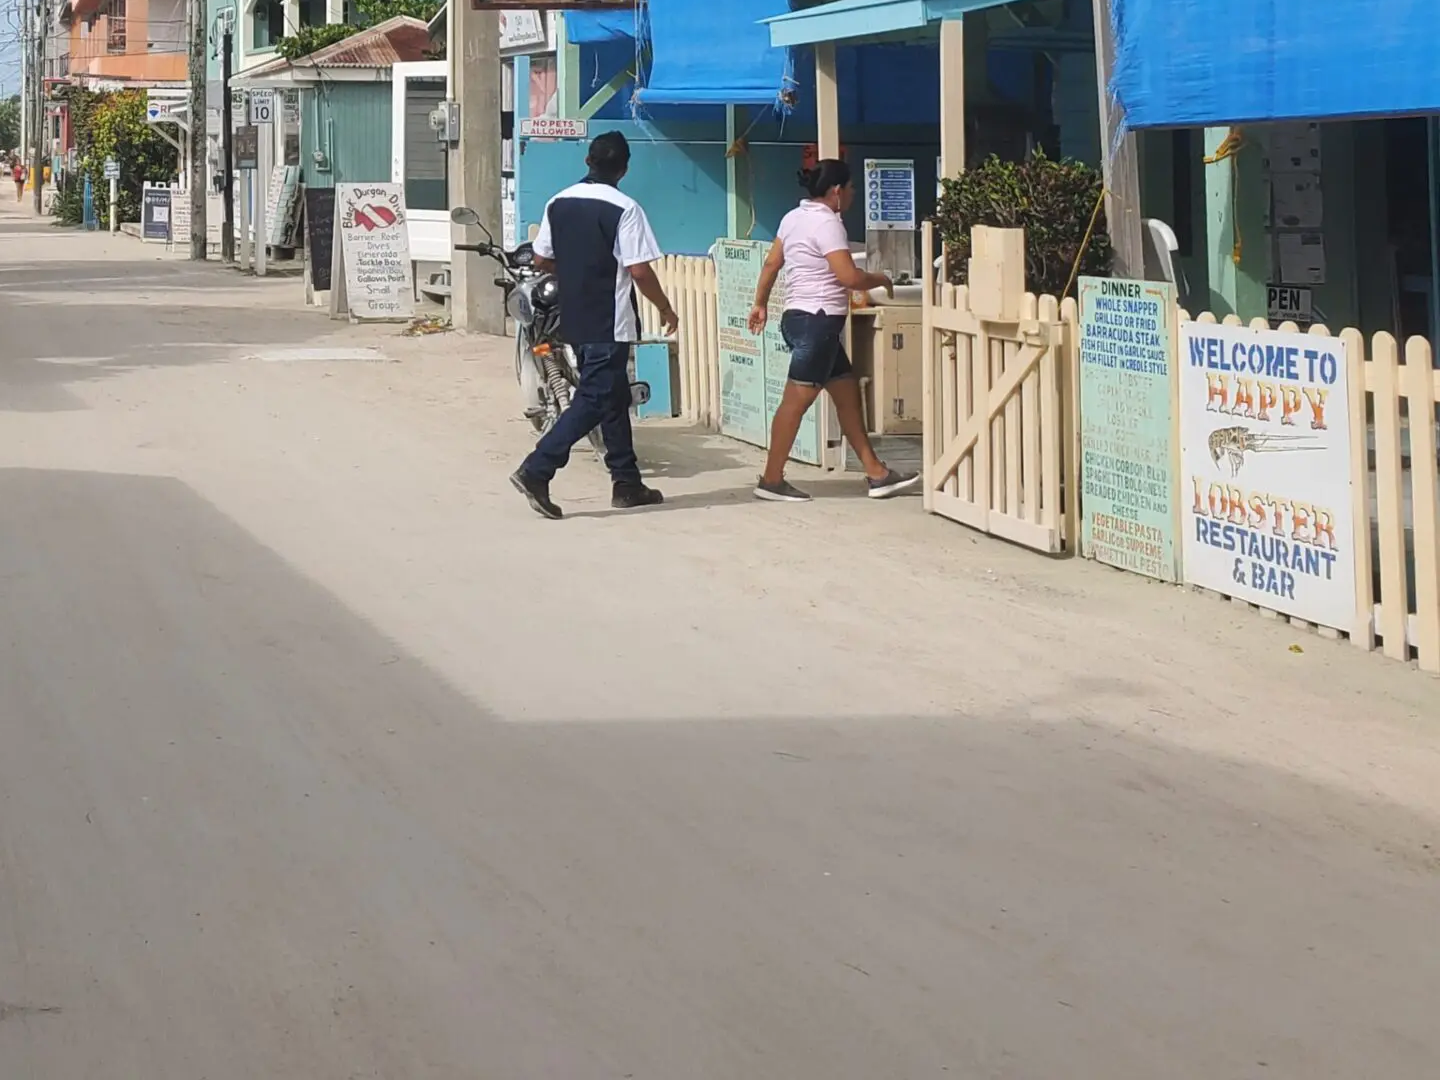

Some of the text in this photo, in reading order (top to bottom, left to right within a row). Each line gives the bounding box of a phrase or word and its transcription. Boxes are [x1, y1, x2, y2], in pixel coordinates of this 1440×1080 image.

[255, 107, 269, 120] 10
[342, 188, 405, 229] Black Durgan Dives
[348, 233, 401, 241] Barrier Reef
[725, 247, 750, 261] BREAKFAST
[366, 284, 391, 294] Small
[1101, 281, 1141, 299] DINNER
[1268, 288, 1300, 310] PEN
[368, 301, 400, 312] Groups
[1095, 297, 1158, 316] WHOLE SNAPPER
[1094, 312, 1156, 331] GRILLED OR FRIED
[1086, 324, 1160, 346] BARRACUDA STEAK
[729, 354, 753, 365] SANDWICH
[1081, 339, 1165, 361] FISH FILLET IN GARLIC SAUCE
[1189, 336, 1337, 384] WELCOME TO
[1082, 352, 1167, 375] FISH FILLET IN CREOLE STYLE
[1205, 372, 1330, 430] HAPPY
[1085, 451, 1115, 470] CHICKEN
[1115, 459, 1145, 478] CORDON
[1147, 465, 1167, 482] BLEU
[1085, 467, 1124, 487] SPAGHETTI
[1085, 481, 1168, 514] BREADED CHICKEN AND
[1192, 475, 1340, 552] LOBSTER
[1092, 511, 1164, 544] VEGETABLE PASTA
[1092, 528, 1117, 545] GARLIC
[1125, 536, 1162, 559] SUPREME
[1196, 516, 1336, 580] RESTAURANT
[1232, 557, 1295, 600] & BAR
